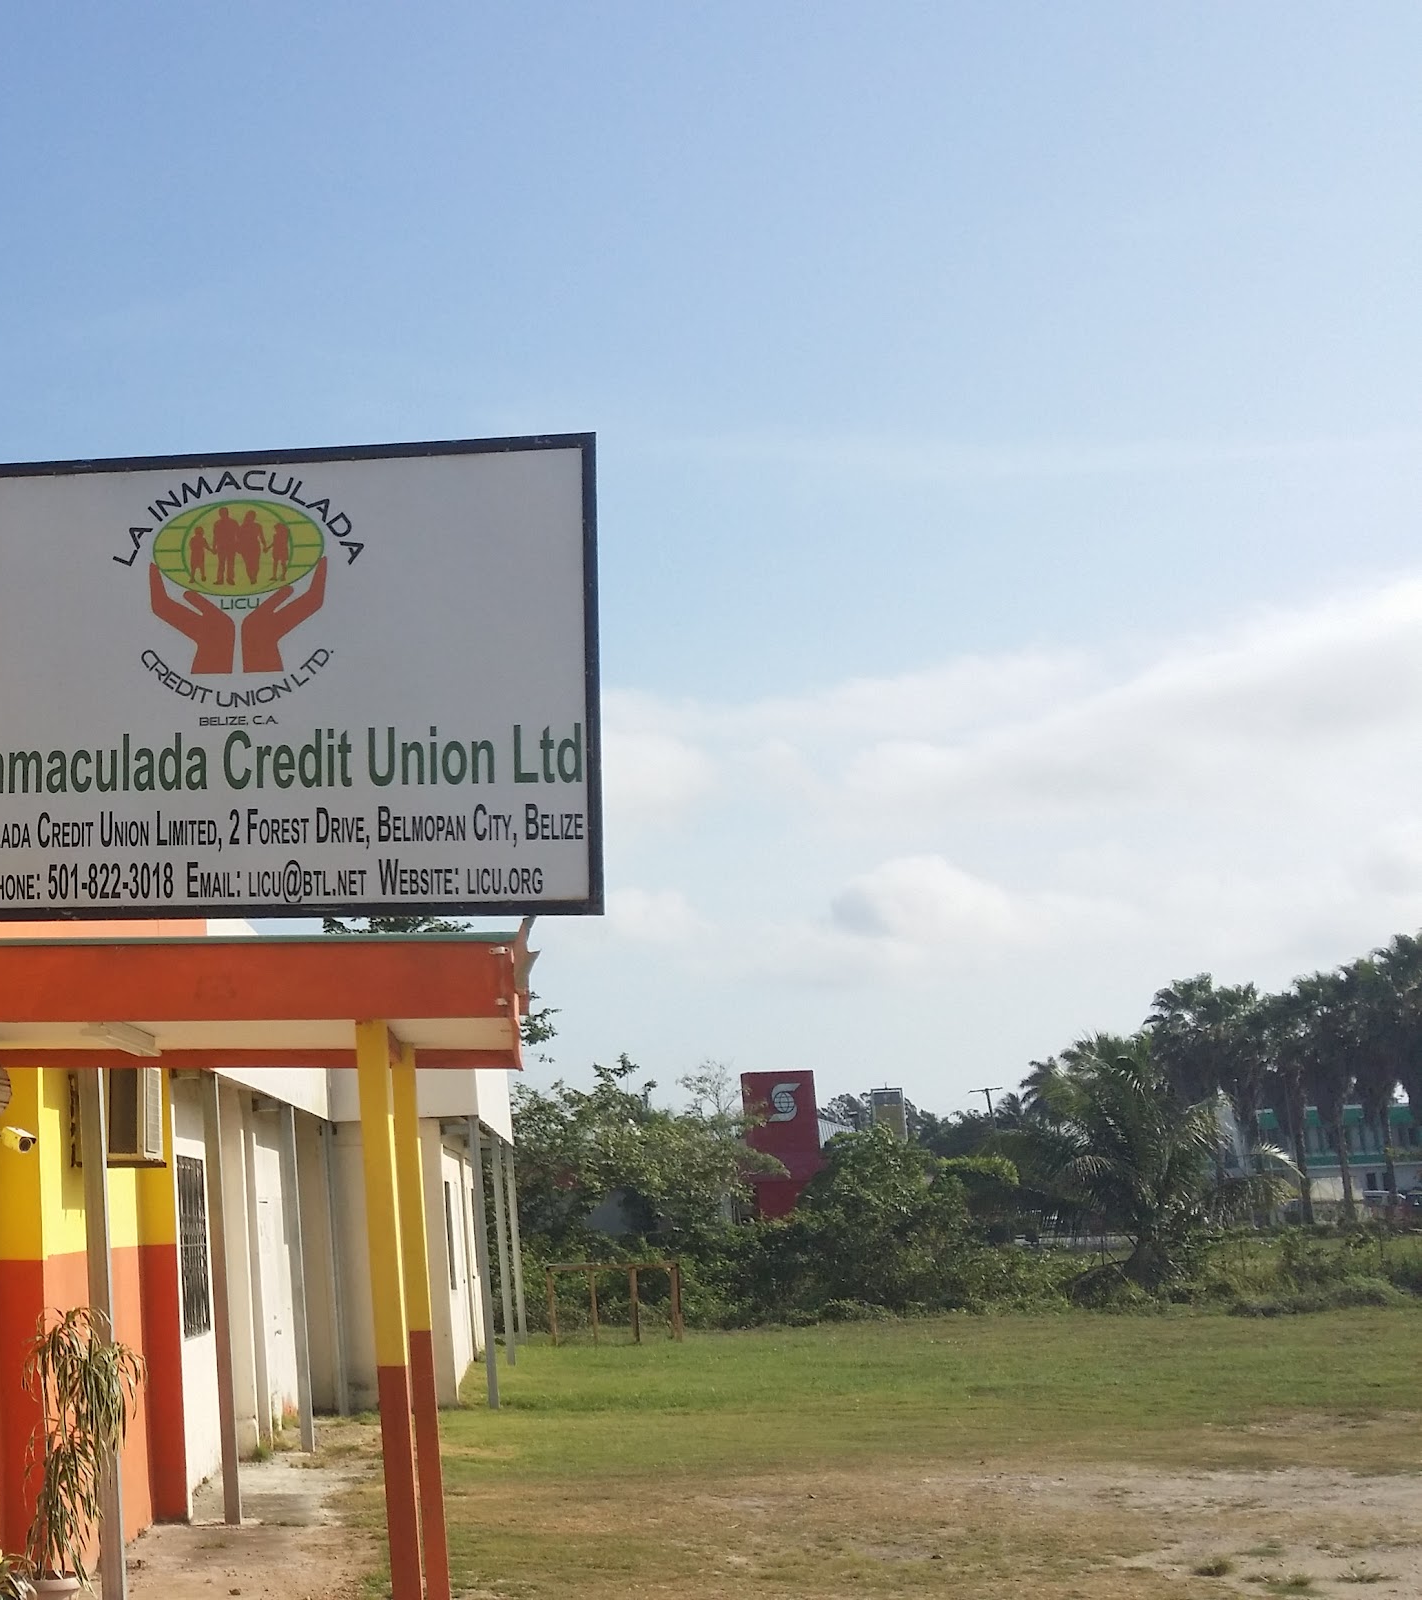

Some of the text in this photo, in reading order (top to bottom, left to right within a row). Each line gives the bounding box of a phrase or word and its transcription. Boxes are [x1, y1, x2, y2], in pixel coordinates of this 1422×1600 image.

[113, 470, 365, 567] LA INMACULADA
[221, 598, 260, 610] LICU
[141, 648, 335, 708] CREDIT UNION LTD.
[199, 716, 249, 726] BELIZE,
[223, 729, 352, 790] Credit
[368, 726, 495, 787] Union
[514, 722, 583, 784] Ltd
[38, 811, 94, 848] CREDIT
[100, 811, 149, 847] UNION
[156, 810, 223, 852] LIMITED,
[229, 808, 240, 845] 2
[247, 808, 309, 845] FOREST
[316, 807, 370, 849] DRIVE,
[378, 805, 466, 842] BELMOPAN
[473, 803, 518, 848] CITY,
[525, 803, 584, 841] BELIZE
[48, 861, 174, 900] 501-822-3018
[187, 861, 241, 898] EMAIL:
[248, 859, 367, 903] LICU@BTL.NET
[378, 858, 459, 895] WEBSITE:
[467, 867, 544, 896] LICU.ORG
